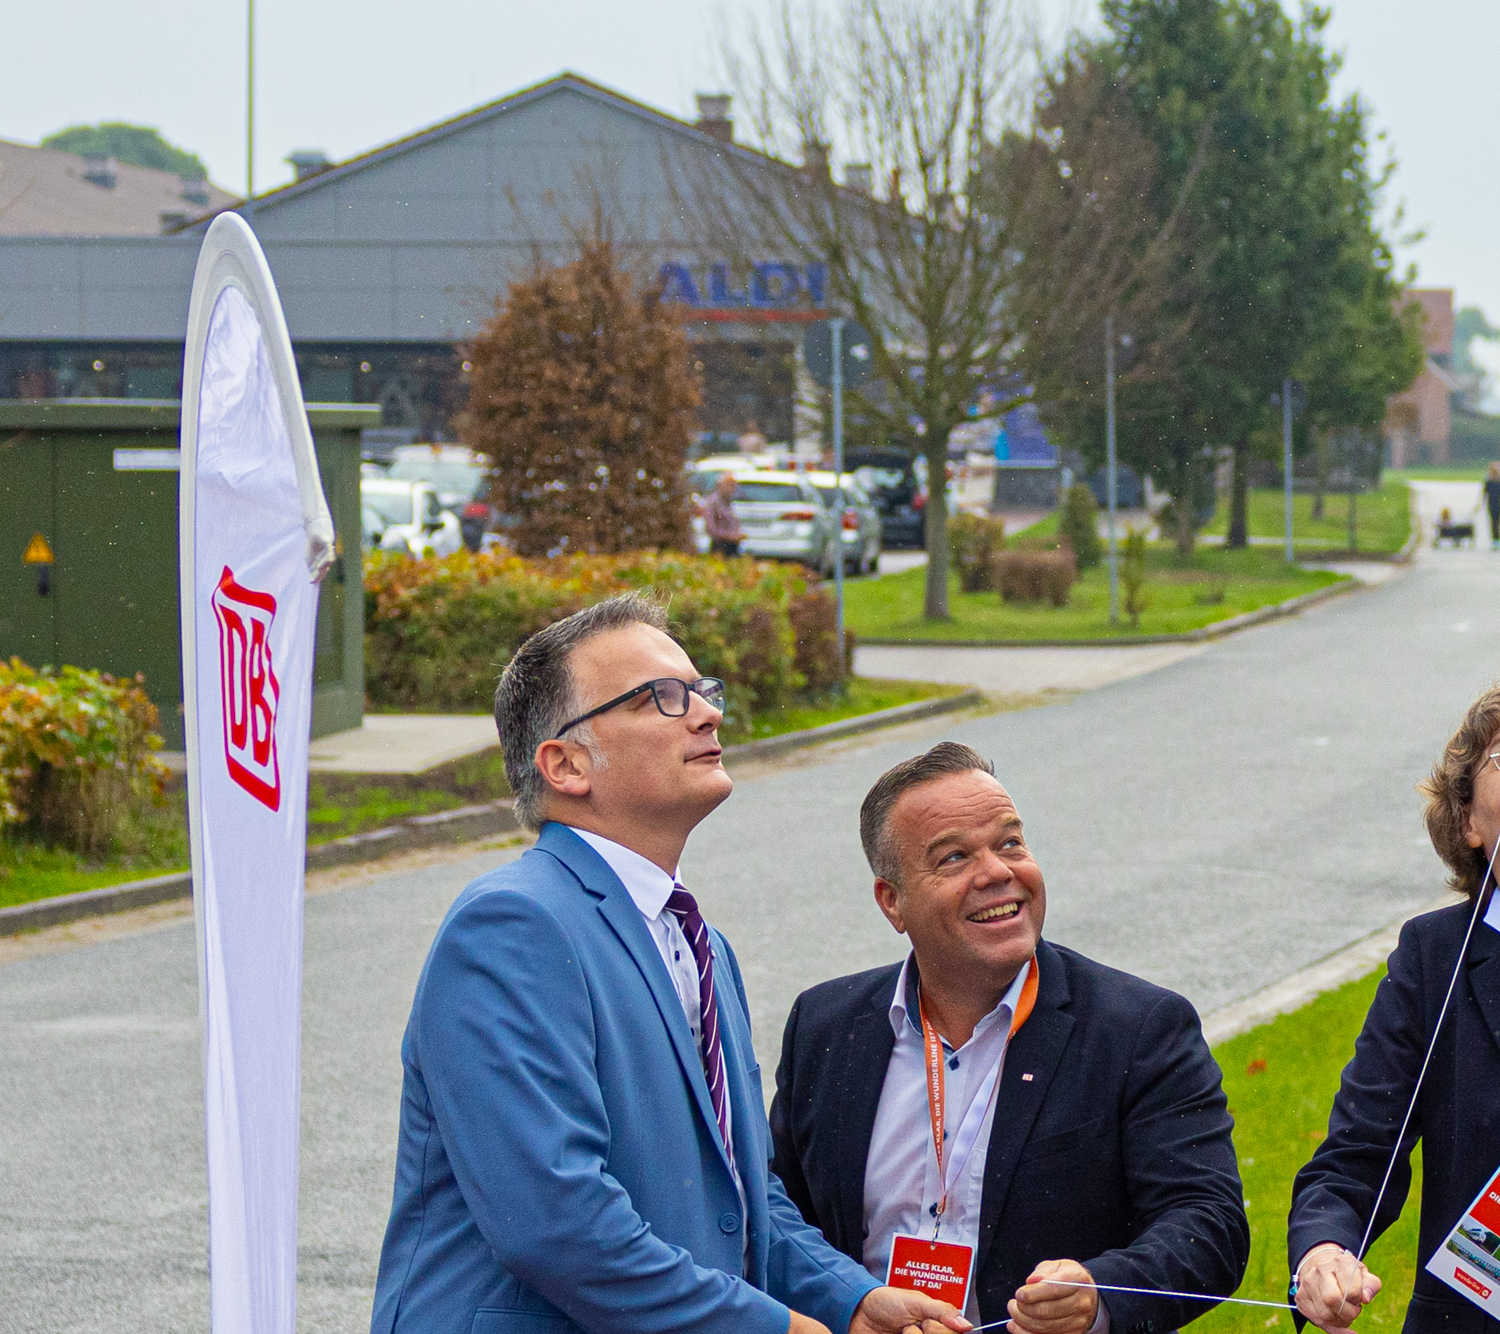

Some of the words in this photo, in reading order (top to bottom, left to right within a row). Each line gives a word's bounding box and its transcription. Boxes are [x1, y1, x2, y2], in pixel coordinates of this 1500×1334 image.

[659, 261, 827, 307] ALDI
[216, 599, 275, 768] DB
[931, 1042, 940, 1101] WUNDERLINE
[894, 1267, 909, 1276] DIE
[909, 1269, 964, 1285] WUNDERLINE
[906, 1260, 930, 1271] ALLES
[931, 1264, 955, 1276] KLAR,
[913, 1278, 927, 1287] IST
[927, 1281, 942, 1290] DA!
